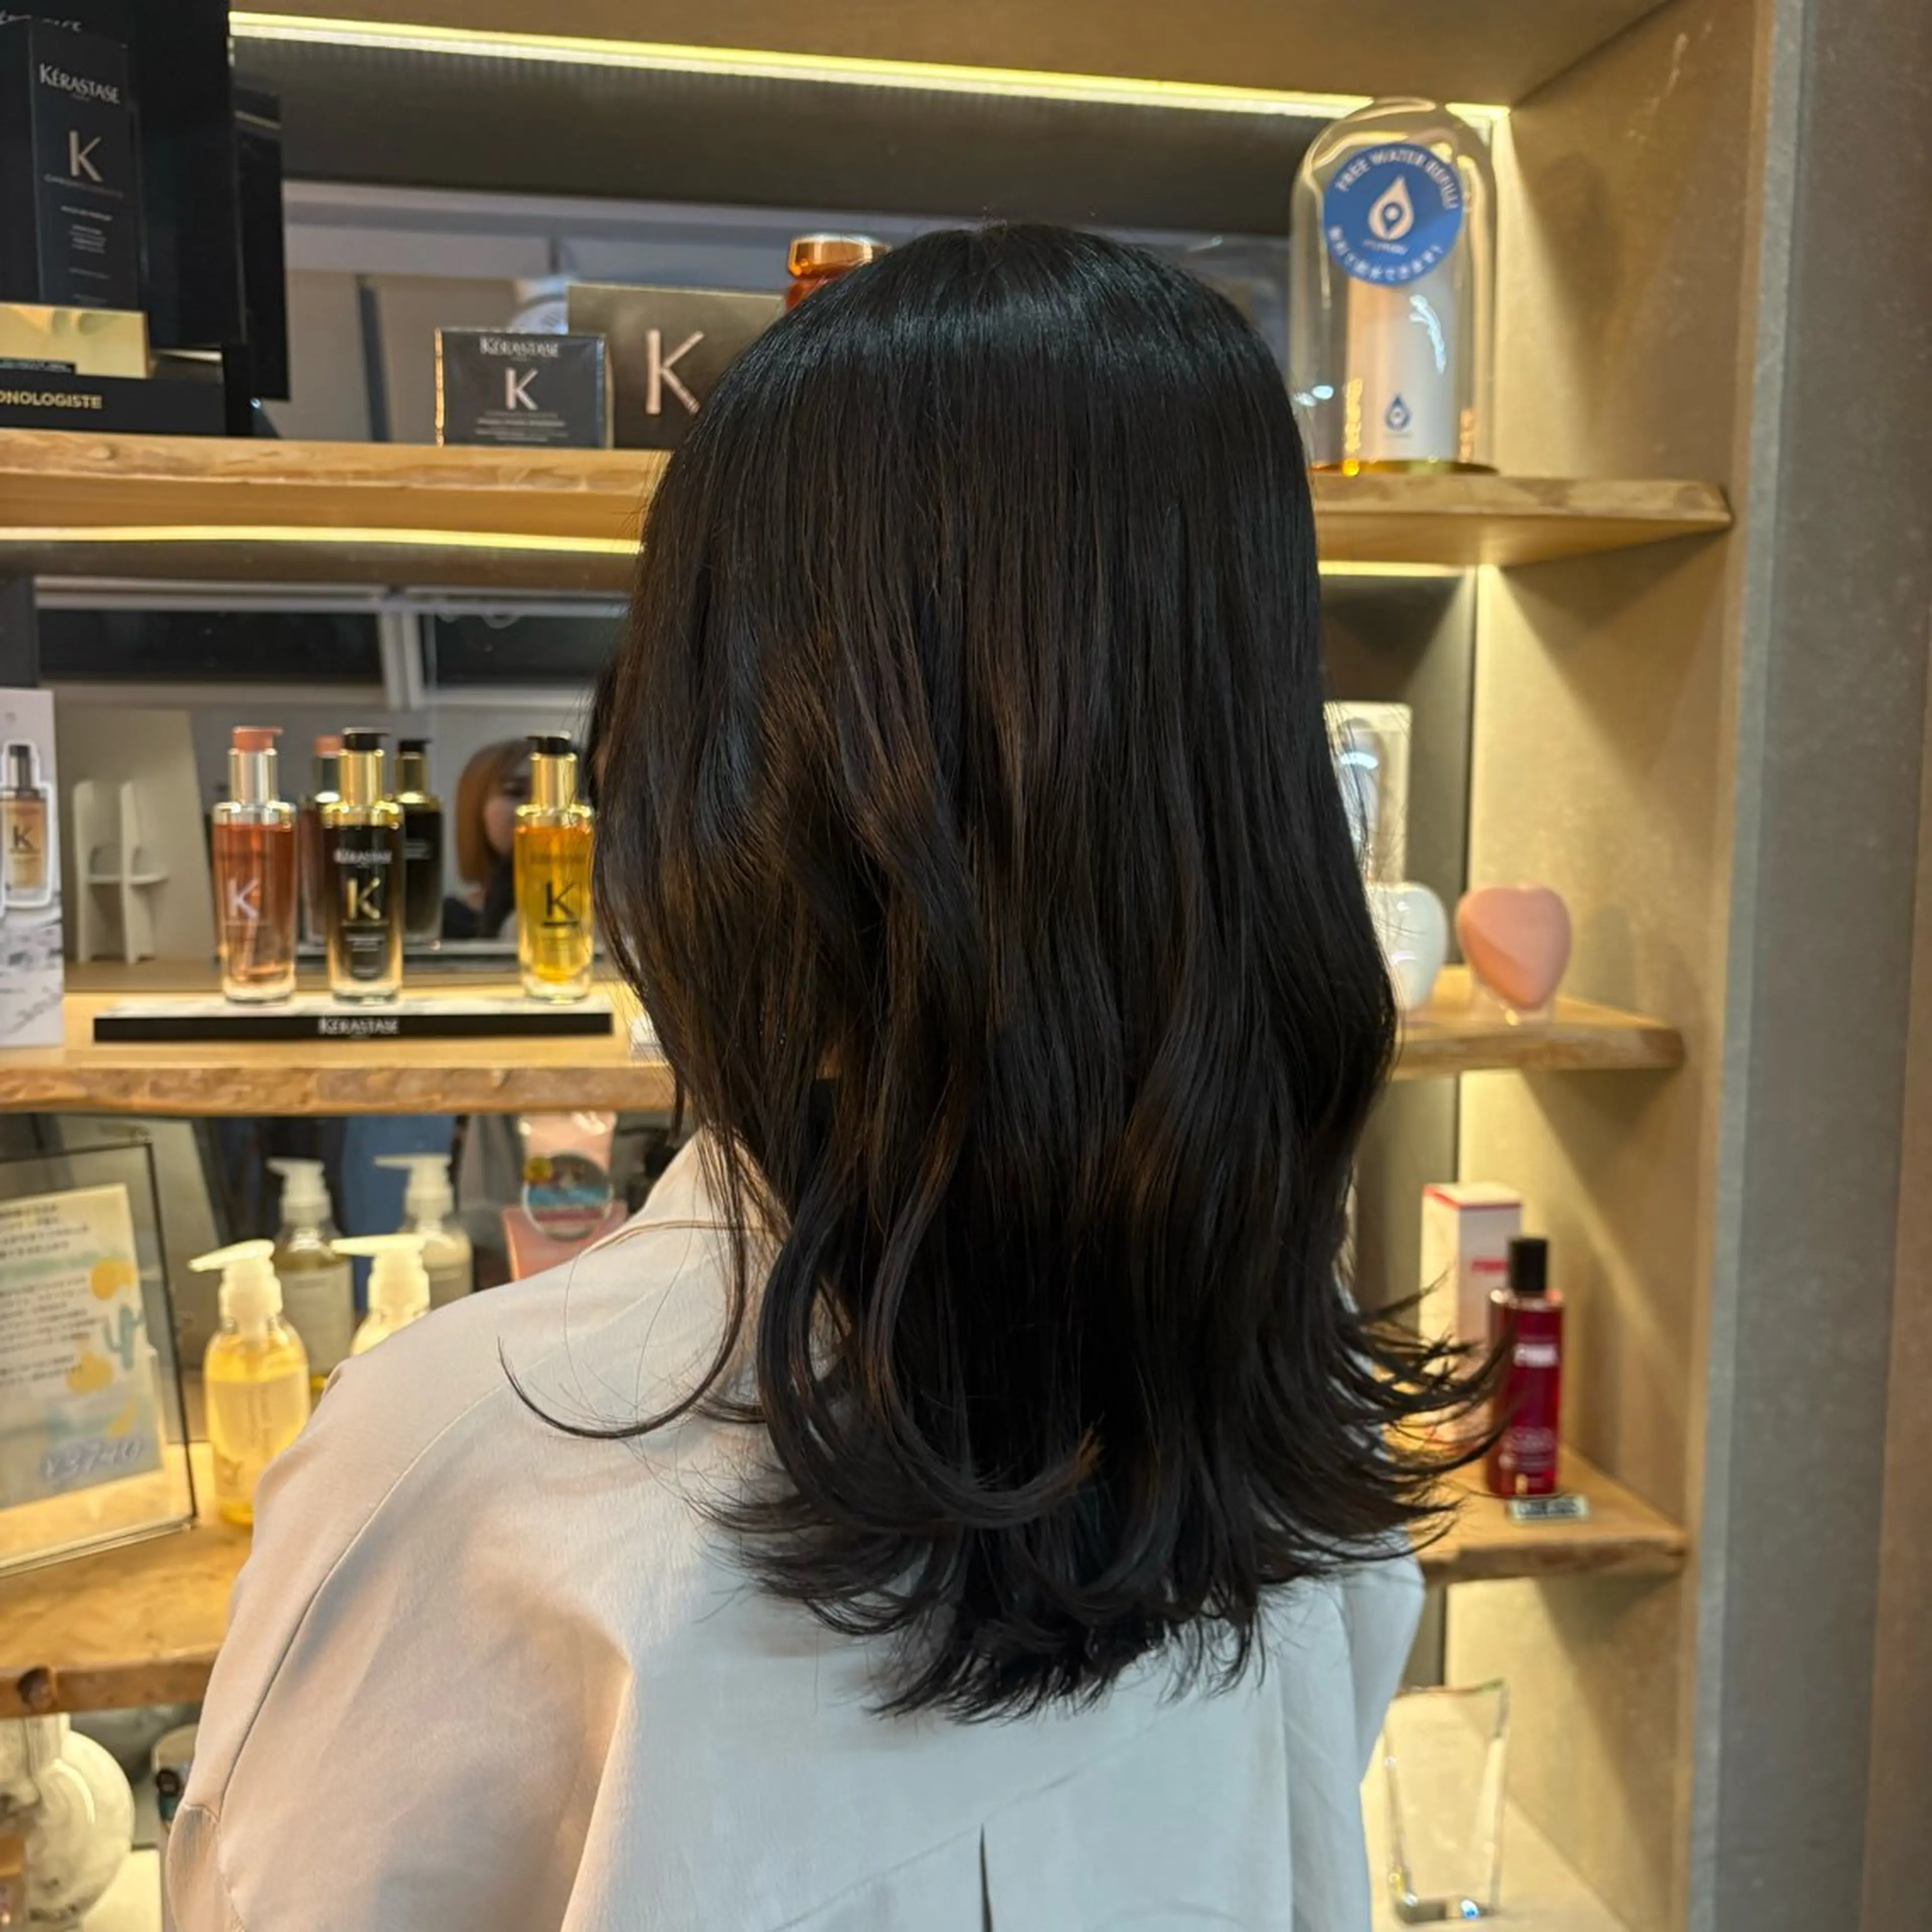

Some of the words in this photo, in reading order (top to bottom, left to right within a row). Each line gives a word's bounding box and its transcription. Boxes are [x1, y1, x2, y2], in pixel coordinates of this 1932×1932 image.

[69, 130, 103, 182] K
[1335, 158, 1371, 192] FREE
[1369, 149, 1427, 167] WATER
[505, 367, 539, 411] K
[645, 328, 704, 415] K
[13, 824, 35, 849] K
[228, 878, 261, 919] K
[347, 877, 381, 920] K
[545, 881, 577, 918] K
